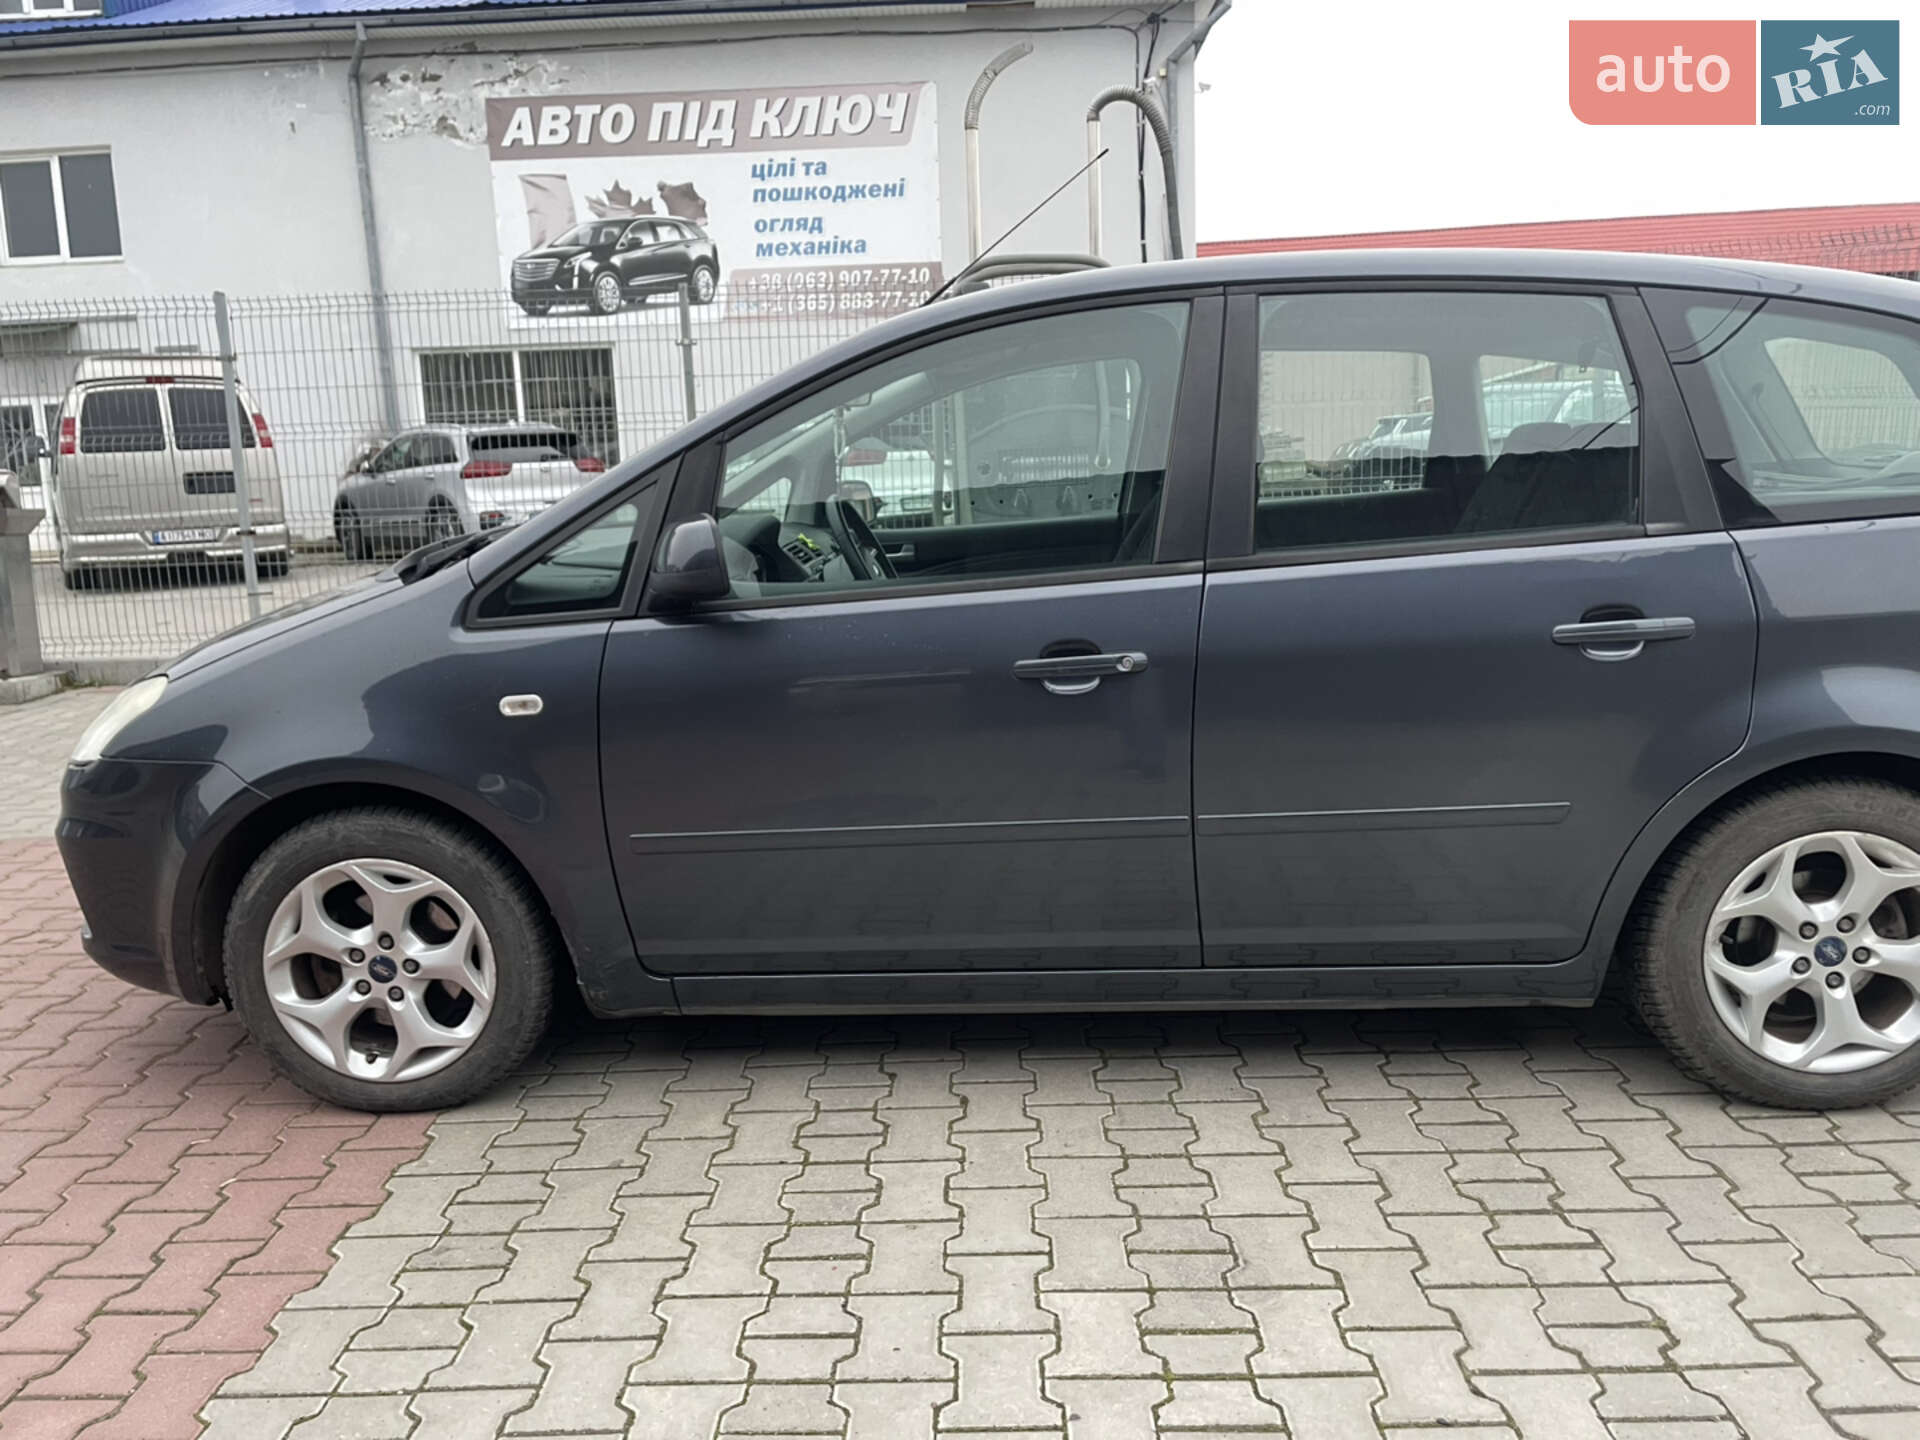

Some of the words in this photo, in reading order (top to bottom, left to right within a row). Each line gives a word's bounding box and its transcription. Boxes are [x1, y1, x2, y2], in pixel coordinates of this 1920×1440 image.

[501, 104, 636, 147] АВТО
[647, 100, 736, 148] ПІД
[750, 92, 910, 138] КЛЮЧ
[751, 157, 796, 181] цілі
[802, 160, 827, 176] та
[753, 177, 905, 203] пошкоджені
[754, 216, 823, 234] огляд
[755, 235, 867, 257] механіка
[839, 267, 930, 287] 907-77-10
